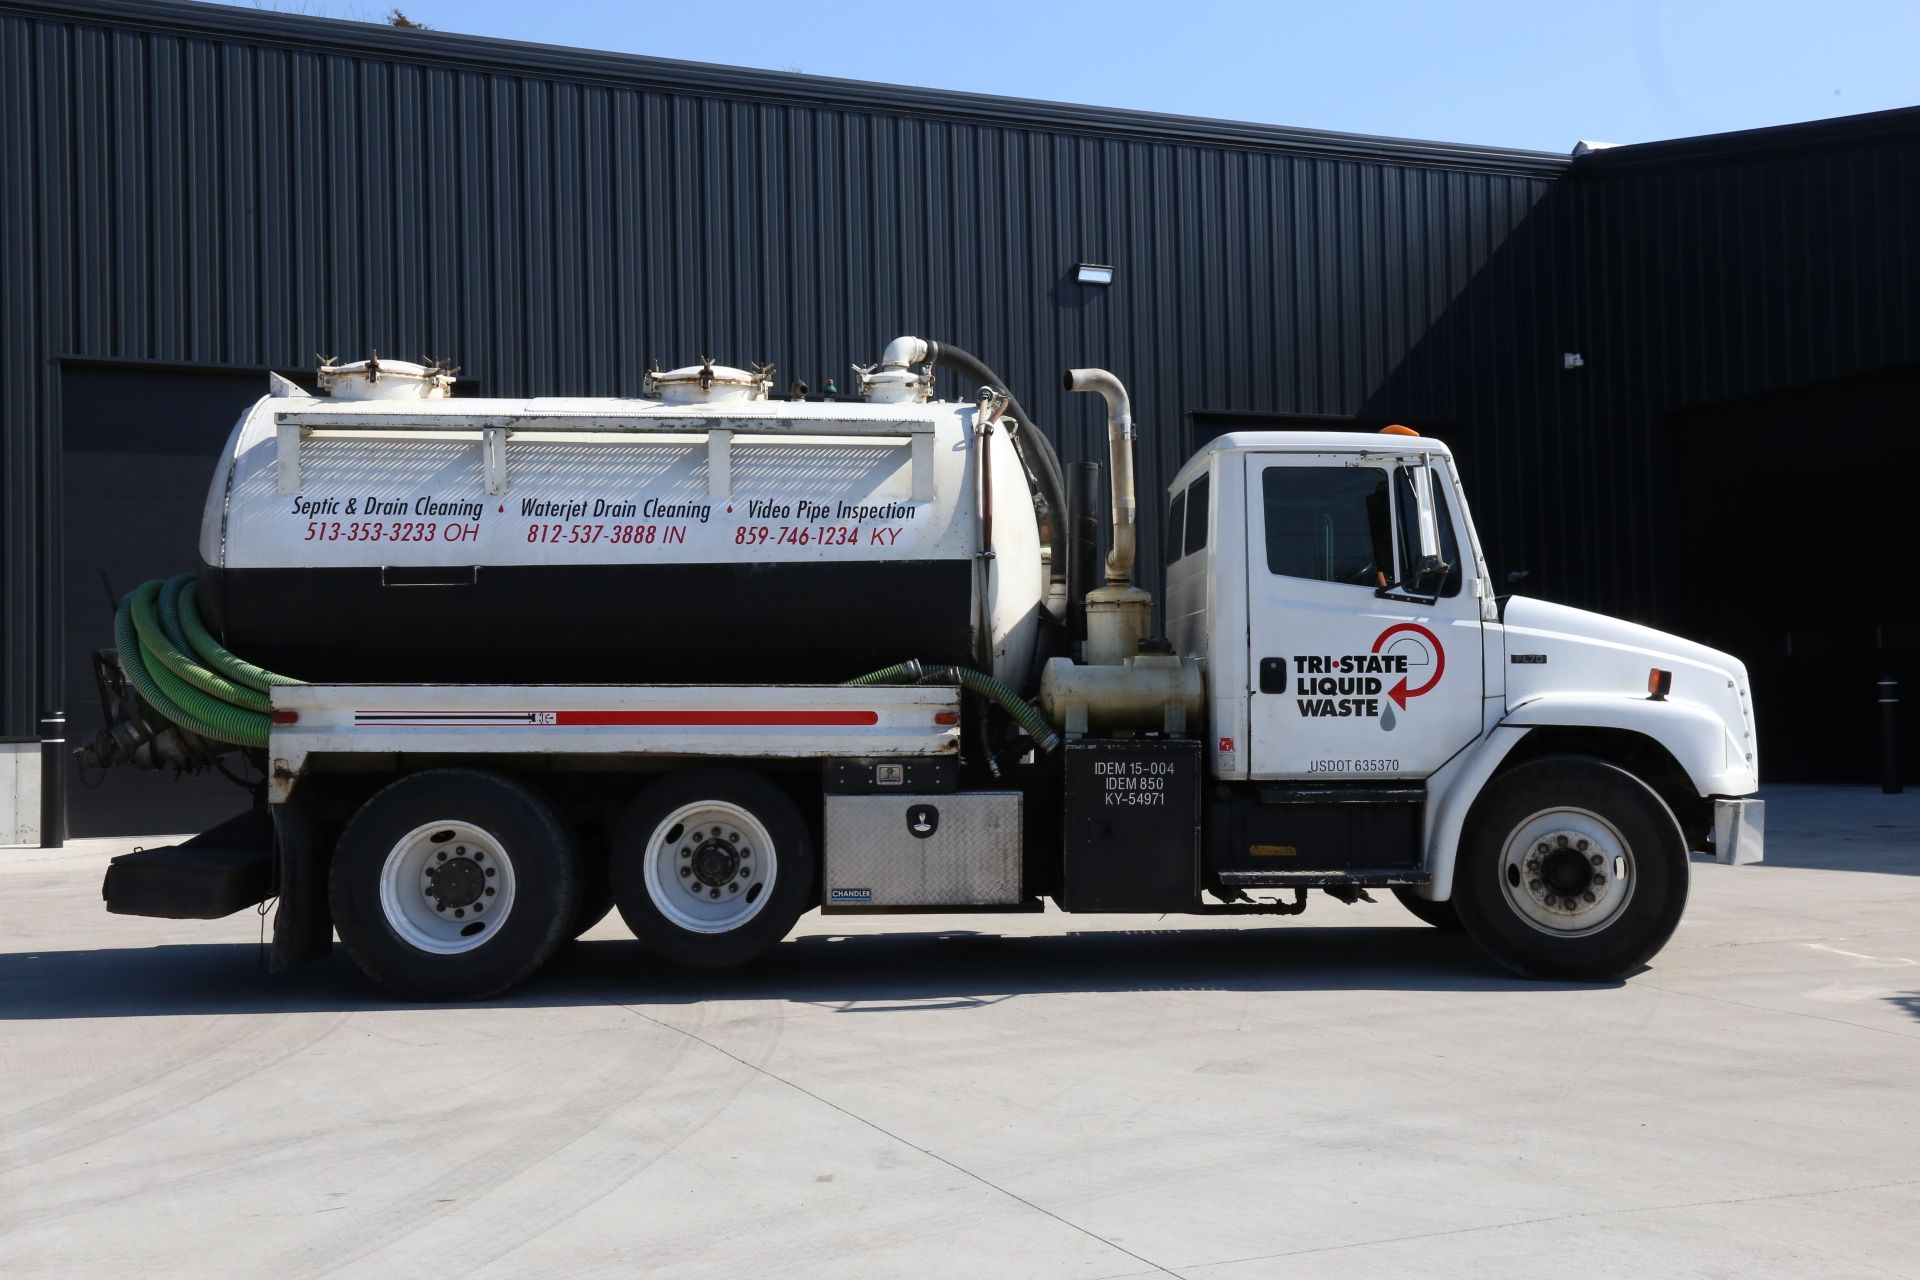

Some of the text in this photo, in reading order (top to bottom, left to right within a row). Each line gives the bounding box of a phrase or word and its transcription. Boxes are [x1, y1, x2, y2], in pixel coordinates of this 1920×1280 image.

[291, 496, 484, 521] Septic & Drain Cleaning
[521, 498, 711, 523] Waterjet Drain Cleaning
[749, 500, 916, 523] Video Pipe Inspection
[304, 522, 480, 542] 513-353-3233 OH
[527, 524, 687, 544] 812-537-3888 IN
[735, 526, 903, 546] 859-746-1234 KY
[1297, 677, 1382, 696] LIQUID
[1297, 698, 1379, 717] WASTE
[1094, 762, 1175, 775] IDEM 15-004
[1310, 759, 1400, 772] USDOT 635370
[1105, 777, 1164, 790] IDEM 850
[1105, 792, 1165, 805] KY-54971
